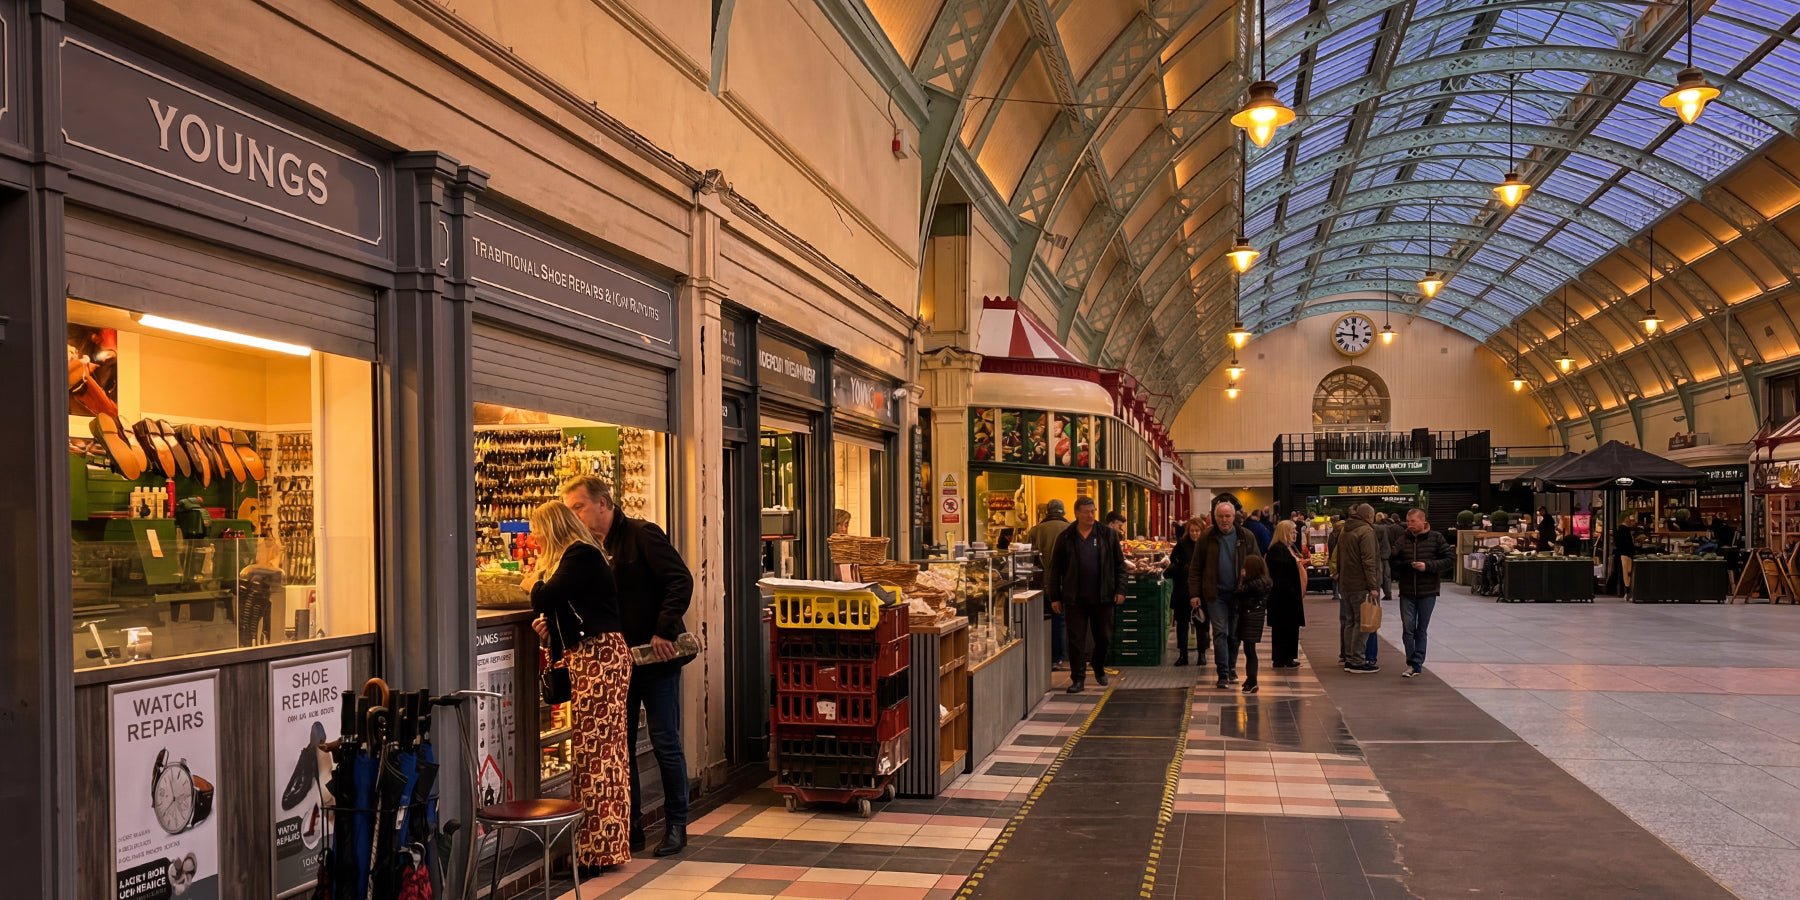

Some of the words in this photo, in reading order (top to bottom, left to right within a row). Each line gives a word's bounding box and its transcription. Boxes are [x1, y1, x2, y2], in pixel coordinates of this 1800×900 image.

[147, 97, 328, 206] YOUNGS
[541, 263, 567, 288] SHOE
[568, 274, 604, 300] REPAIRS
[292, 667, 329, 689] SHOE
[133, 689, 197, 717] WATCH
[282, 685, 338, 711] REPAIRS
[127, 711, 204, 742] REPAIRS
